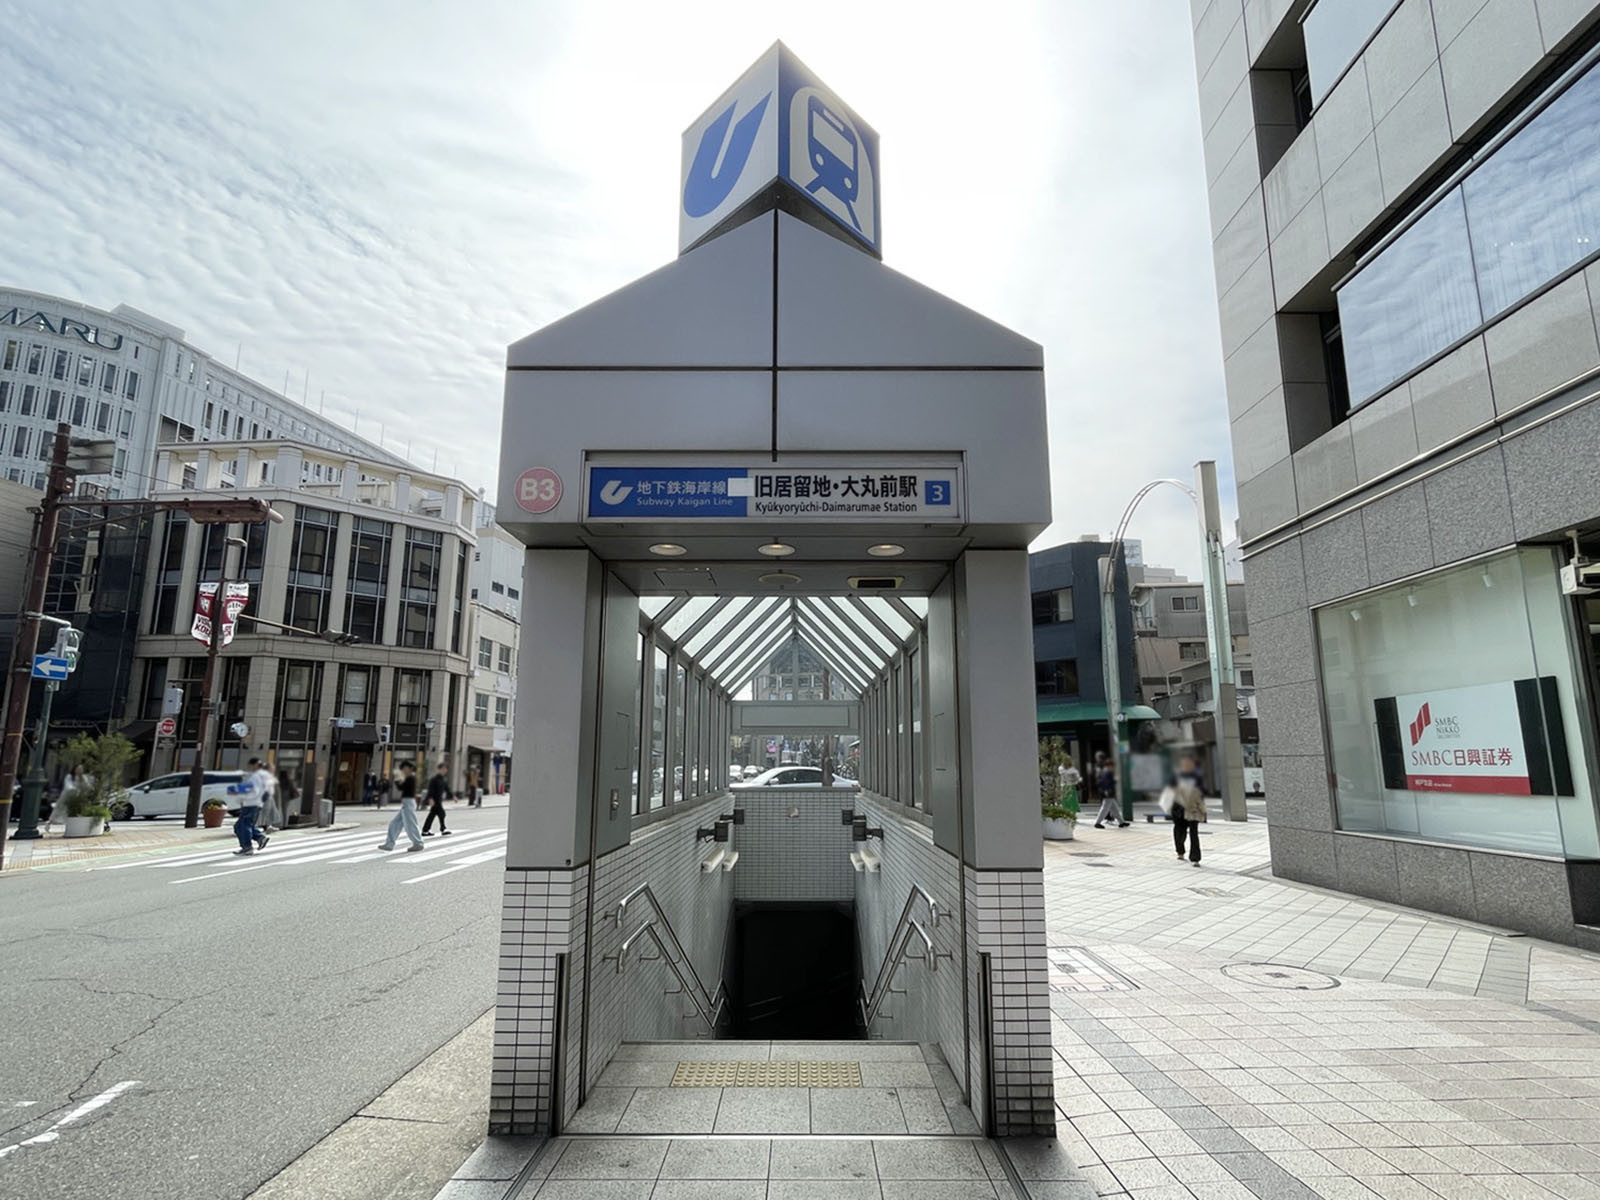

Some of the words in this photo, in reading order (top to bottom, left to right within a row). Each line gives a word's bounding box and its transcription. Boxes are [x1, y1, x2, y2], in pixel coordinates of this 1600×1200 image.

[521, 478, 555, 501] B3
[637, 480, 727, 495] 地下鉄海岸線
[755, 475, 918, 498] 旧居留地・大丸前駅
[932, 485, 944, 502] 3
[637, 498, 674, 506] Subway
[678, 498, 709, 507] Kaigan
[713, 498, 733, 506] Line
[884, 501, 918, 512] Station
[1435, 716, 1458, 727] SMBC
[1411, 747, 1513, 766] SMBC日興証券
